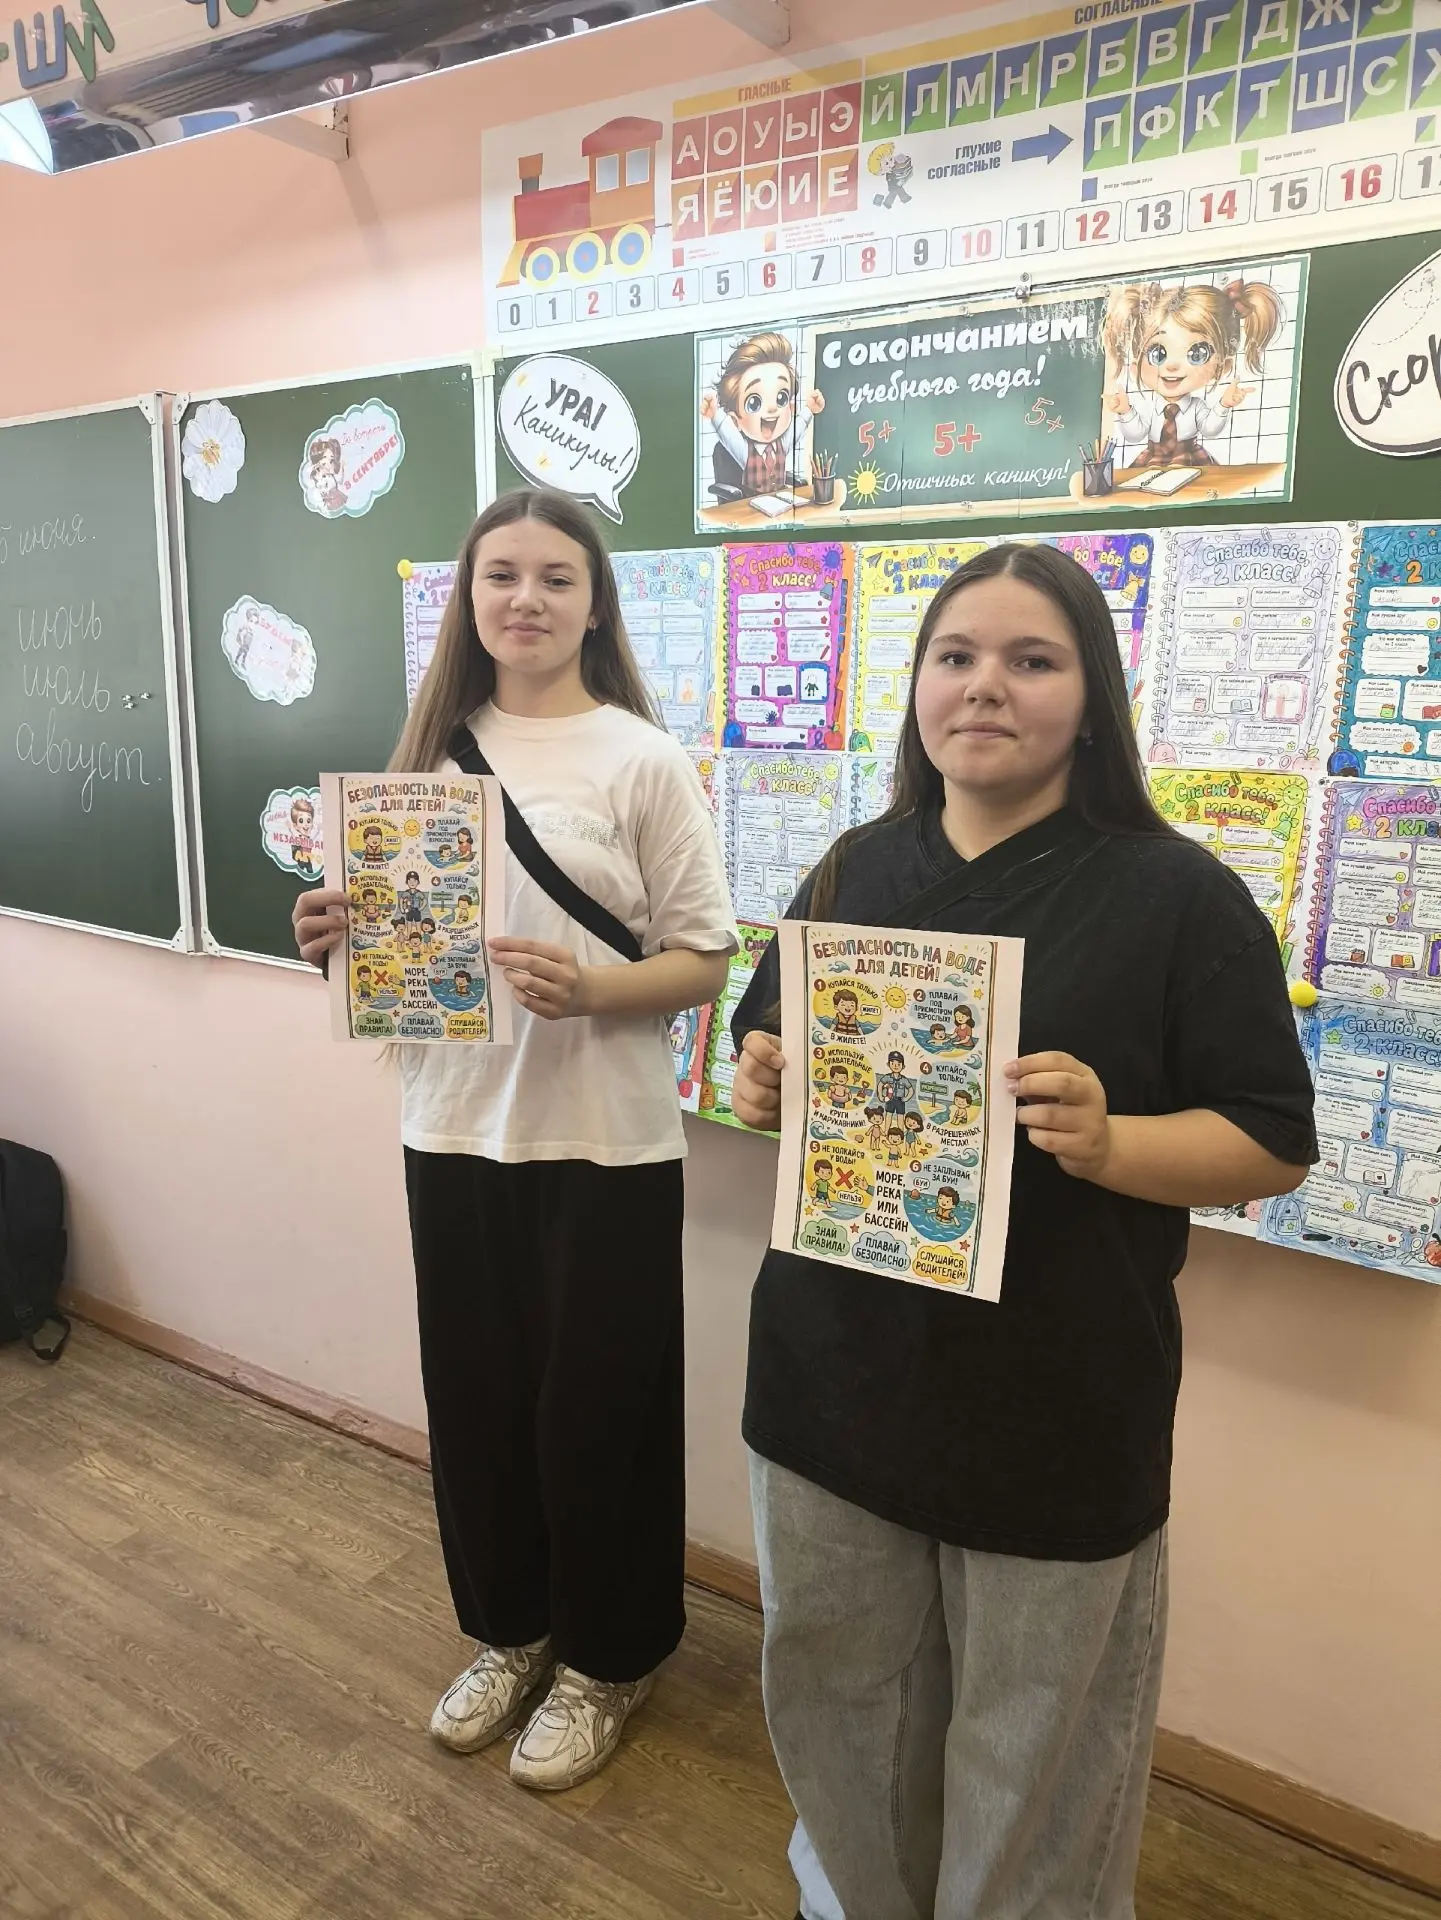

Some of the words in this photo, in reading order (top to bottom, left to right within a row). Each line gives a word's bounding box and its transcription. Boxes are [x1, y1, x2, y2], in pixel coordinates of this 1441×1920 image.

[1074, 0, 1163, 25] СОГЛАСН
[676, 134, 700, 165] А
[713, 127, 738, 156] О
[753, 118, 774, 149] У
[786, 108, 817, 142] Ы
[830, 101, 855, 133] Э
[871, 83, 894, 126] Й
[912, 82, 940, 117] Л
[956, 71, 987, 109] М
[1003, 62, 1029, 99] Н
[1050, 52, 1077, 89] Р
[1098, 39, 1126, 79] Б
[1148, 27, 1178, 66] В
[1203, 13, 1231, 53] Г
[1252, 2, 1289, 50] Д
[738, 78, 792, 102] ГЛАСНЫЕ
[677, 196, 699, 227] Я
[714, 181, 734, 218] Ё
[744, 180, 777, 214] Ю
[789, 175, 811, 205] И
[828, 165, 850, 197] Е
[1093, 114, 1121, 152] П
[1139, 104, 1176, 140] Ф
[1195, 91, 1224, 132] К
[1250, 79, 1280, 119] Т
[1296, 65, 1347, 111] Ш
[1362, 56, 1399, 96] С
[955, 140, 1002, 160] глухие
[927, 156, 1001, 180] согласные
[510, 303, 521, 326] 0
[548, 298, 557, 320] 1
[587, 291, 599, 315] 2
[630, 284, 641, 307] 3
[671, 277, 685, 301] 4
[717, 270, 730, 295] 5
[763, 262, 776, 288] 6
[810, 254, 825, 282] 7
[861, 247, 876, 273] 8
[914, 239, 929, 266] 9
[962, 229, 992, 259] 10
[1017, 219, 1045, 250] 11
[1076, 210, 1109, 242] 12
[1138, 200, 1171, 232] 13
[1200, 189, 1237, 223] 14
[1270, 178, 1308, 212] 15
[1341, 164, 1382, 201] 16
[823, 340, 842, 369] С
[848, 314, 1088, 367] окончанием
[848, 370, 959, 413] учебного
[968, 355, 1046, 398] года!
[1347, 334, 1441, 425] Ско
[545, 378, 608, 432] УРА!
[514, 395, 634, 474] Каникулы!
[858, 420, 896, 458] 5+
[933, 421, 982, 457] 5+
[883, 470, 976, 493] Отличных
[984, 458, 1071, 487] каникул!
[1202, 538, 1270, 567] Спасибо
[1272, 543, 1310, 568] тебе,
[749, 553, 795, 576] Спасибо
[883, 552, 936, 578] Спасибо
[1213, 562, 1230, 587] 2
[1233, 563, 1302, 584] класс!
[1406, 559, 1424, 584] 2
[758, 573, 769, 591] 2
[771, 572, 818, 588] класс!
[892, 573, 906, 595] 2
[18, 600, 102, 652] июнь
[23, 665, 110, 712] июль
[750, 759, 796, 779] Спасибо
[347, 782, 429, 804] БЕЗОПАСНОСТЬ
[431, 783, 447, 798] НА
[449, 786, 480, 805] ВОДЕ
[758, 777, 770, 795] 2
[771, 777, 818, 796] класс!
[1175, 780, 1240, 803] Спасибо
[1241, 786, 1279, 811] тебе,
[406, 798, 446, 813] ДЕТЕЙ!
[1185, 799, 1201, 822] 2
[1204, 802, 1271, 826] класс!
[1363, 795, 1437, 819] Спасибо
[1375, 815, 1392, 839] 2
[1397, 819, 1441, 838] кла
[812, 938, 919, 960] БЕЗОПАСНОСТЬ
[922, 944, 942, 964] НА
[945, 950, 987, 977] ВОДЕ
[404, 967, 429, 978] МОРЕ,
[855, 958, 885, 975] ДЛЯ
[889, 960, 941, 983] ДЕТЕЙ!
[407, 978, 428, 988] РЕКА
[409, 989, 428, 998] ИЛИ
[827, 978, 855, 989] КУПАЙСЯ
[856, 981, 879, 1000] ТОЛЬКО
[402, 999, 438, 1010] БАССЕЙН
[928, 991, 959, 1002] ПЛАВАЙ
[407, 1016, 435, 1026] ПЛАВАЙ
[1342, 1014, 1414, 1037] Спасибо
[827, 1048, 865, 1061] ИСПОЛЬЗУЙ
[1354, 1032, 1371, 1055] 2
[823, 1057, 873, 1074] ПЛАВАТЕЛЬНЫЕ
[936, 1064, 968, 1077] КУПАЙСЯ
[938, 1073, 965, 1085] ТОЛЬКО
[829, 1108, 849, 1119] КРУГИ
[821, 1145, 831, 1153] НЕ
[832, 1146, 865, 1159] ТОЛКАЙСЯ
[876, 1170, 906, 1188] МОРЕ,
[923, 1165, 932, 1173] НЕ
[932, 1165, 971, 1181] ЗАПЛЫВАЙ
[932, 1173, 942, 1181] ЗА
[876, 1185, 902, 1201] РЕКА
[877, 1201, 899, 1215] ИЛИ
[816, 1226, 837, 1239] ЗНАЙ
[864, 1213, 909, 1233] БАССЕЙН
[805, 1235, 846, 1253] ПРАВИЛА!
[865, 1237, 901, 1254] ПЛАВАЙ
[855, 1247, 908, 1269] БЕЗОПАСНО!
[919, 1250, 964, 1269] СЛУШАЙСЯ
[916, 1261, 967, 1281] РОДИТЕЛЕЙ!
